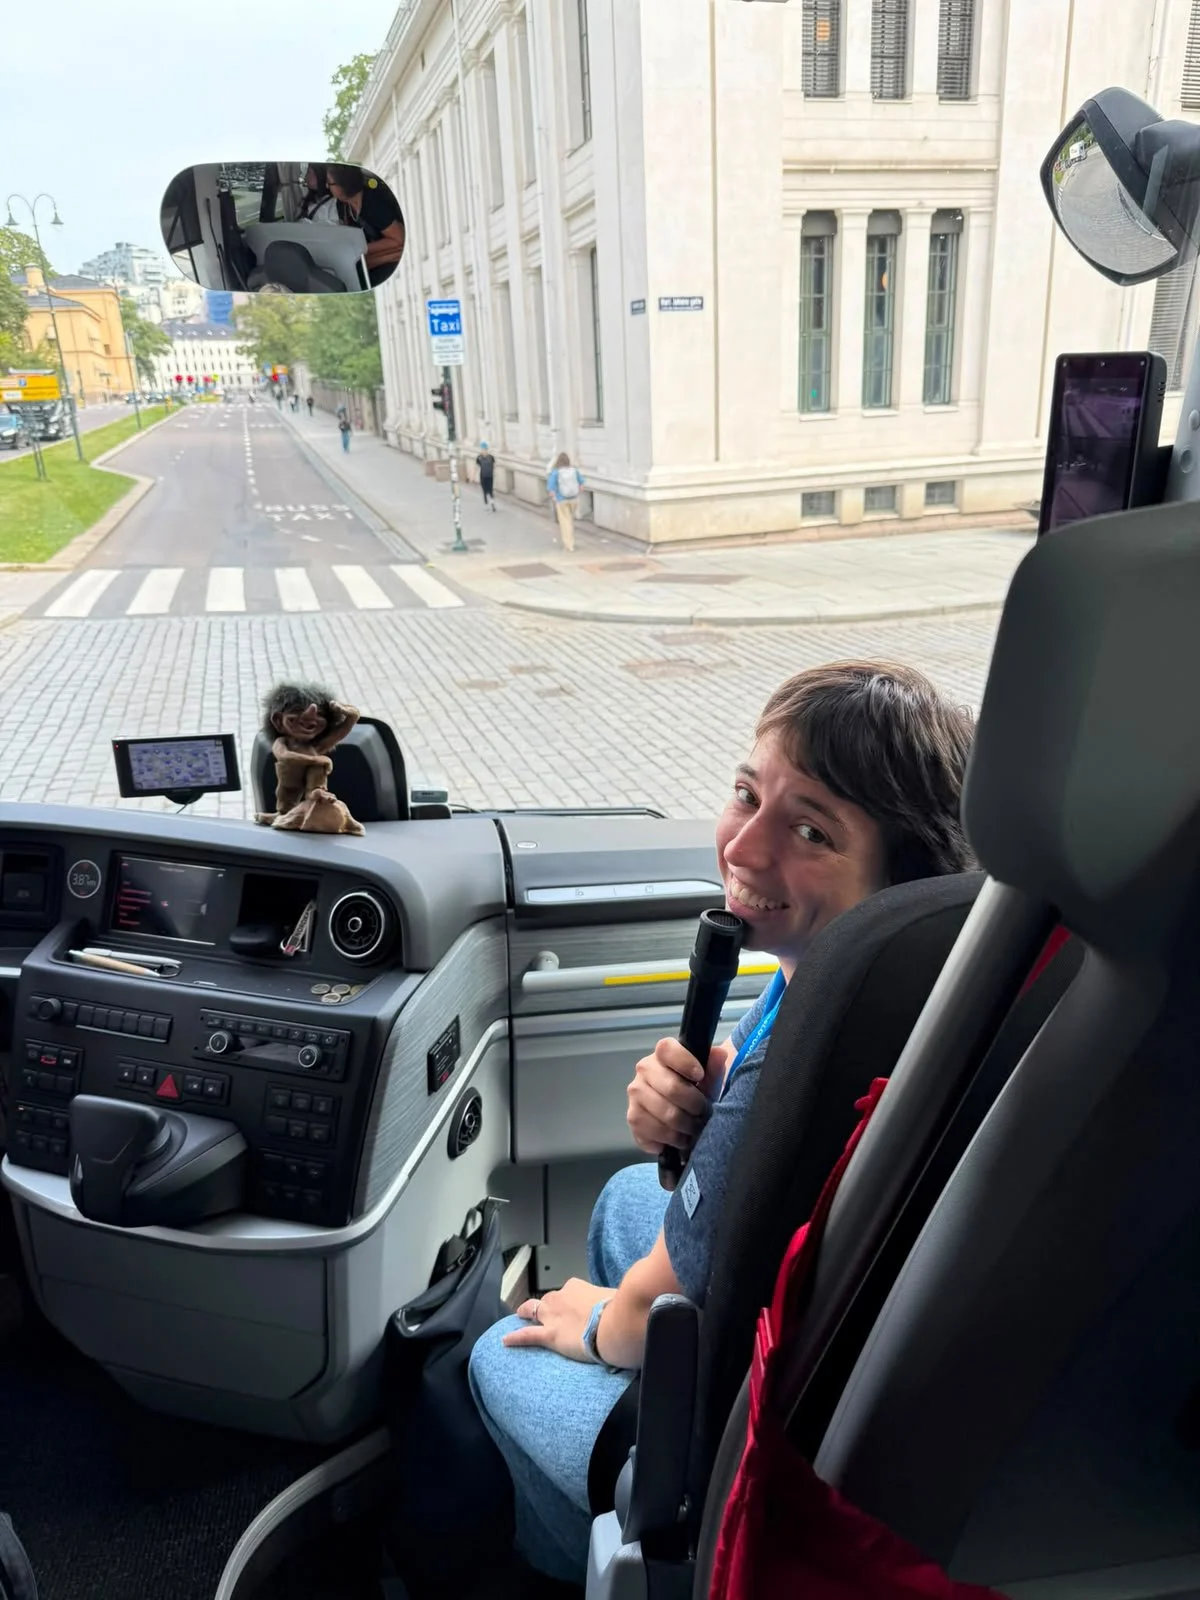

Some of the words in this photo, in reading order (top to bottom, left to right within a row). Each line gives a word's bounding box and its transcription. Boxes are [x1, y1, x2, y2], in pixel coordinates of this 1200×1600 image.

[432, 319, 460, 333] Taxi
[264, 503, 351, 513] BUSS
[266, 511, 354, 522] TAXI
